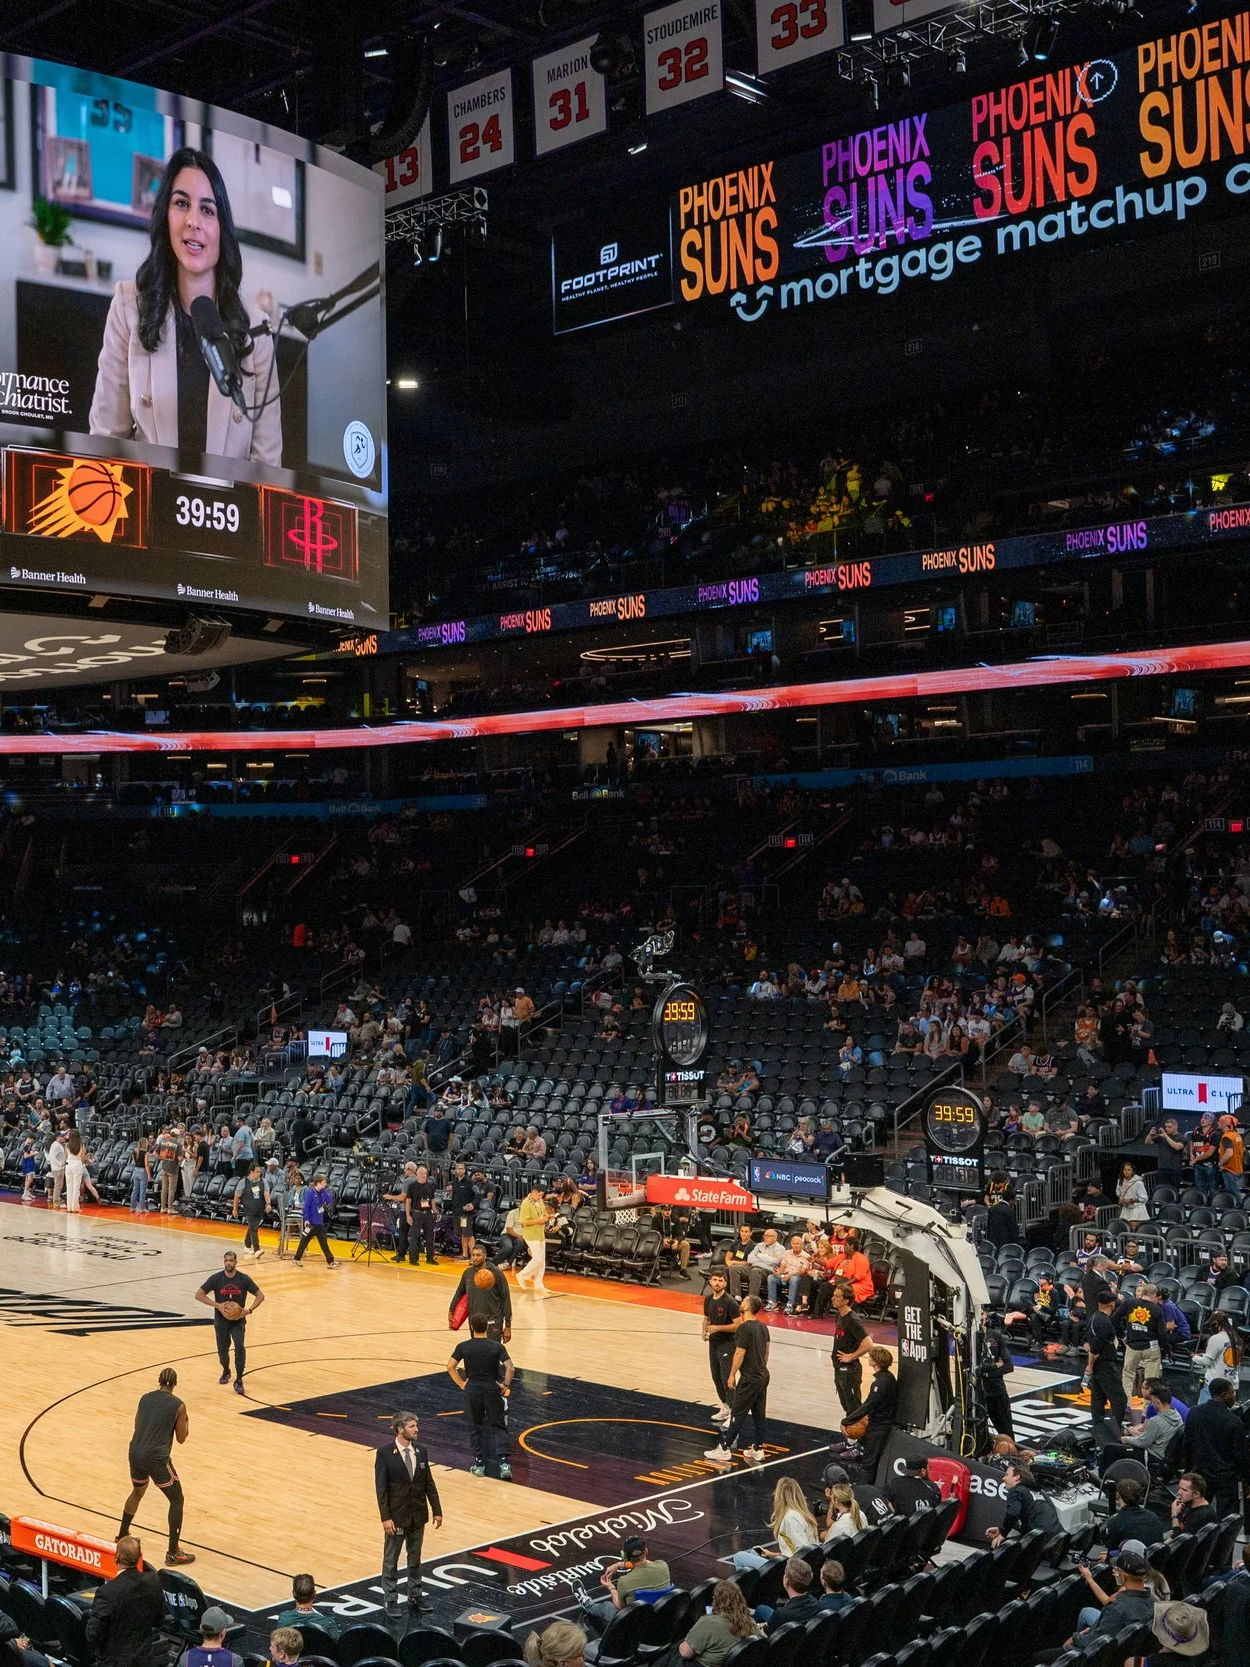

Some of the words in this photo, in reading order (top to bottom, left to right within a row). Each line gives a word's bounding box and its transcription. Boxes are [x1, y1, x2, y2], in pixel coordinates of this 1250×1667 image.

[647, 4, 719, 44] STOUDEMIRE
[771, 0, 828, 50] 33
[547, 55, 588, 84] MARION
[658, 37, 708, 91] 32
[454, 86, 506, 119] CHAMBERS
[550, 81, 590, 131] 31
[972, 62, 1093, 142] PHOENIX
[459, 114, 502, 164] 24
[822, 113, 930, 187] PHOENIX
[385, 146, 419, 192] 13
[973, 114, 1098, 219] SUNS
[680, 161, 776, 230] PHOENIX
[823, 161, 933, 263] SUNS
[680, 206, 779, 301] SUNS
[781, 232, 982, 310] mortgage
[997, 176, 1206, 256] matchup
[561, 255, 660, 294] FOOTPRINT
[1201, 255, 1219, 267] 219
[562, 290, 586, 302] HEALTHY
[610, 278, 634, 289] HEALTHY
[636, 271, 658, 282] PEOPLE
[176, 496, 240, 532] 39:59
[1066, 529, 1105, 552] PHOENIX
[1107, 522, 1148, 553] SUNS
[922, 550, 957, 571] PHOENIX
[959, 544, 996, 573] SUNS
[22, 568, 56, 582] Banner
[56, 570, 86, 584] Health
[698, 584, 728, 602] PHOENIX
[728, 578, 759, 604] SUNS
[804, 567, 836, 588] PHOENIX
[838, 562, 872, 590] SUNS
[186, 586, 214, 598] Banner
[214, 588, 238, 602] Health
[590, 601, 616, 618] PHOENIX
[617, 594, 646, 620] SUNS
[315, 603, 334, 616] Banner
[336, 606, 354, 620] Health
[500, 614, 525, 630] PHOENIX
[526, 608, 551, 634] SUNS
[418, 626, 442, 642] PHOENIX
[442, 621, 466, 644] SUNS
[898, 769, 928, 782] Bank
[572, 790, 589, 800] Bell
[602, 788, 625, 800] Bank
[664, 1002, 695, 1021] 39:59
[1167, 1088, 1194, 1096] ULTRA
[935, 1105, 974, 1124] 39:59
[794, 1176, 822, 1184] peacock
[904, 1306, 922, 1324] GET
[904, 1323, 922, 1340] THE
[910, 1340, 927, 1362] App
[530, 1498, 705, 1558] Michelob
[35, 1534, 102, 1568] GATORADE
